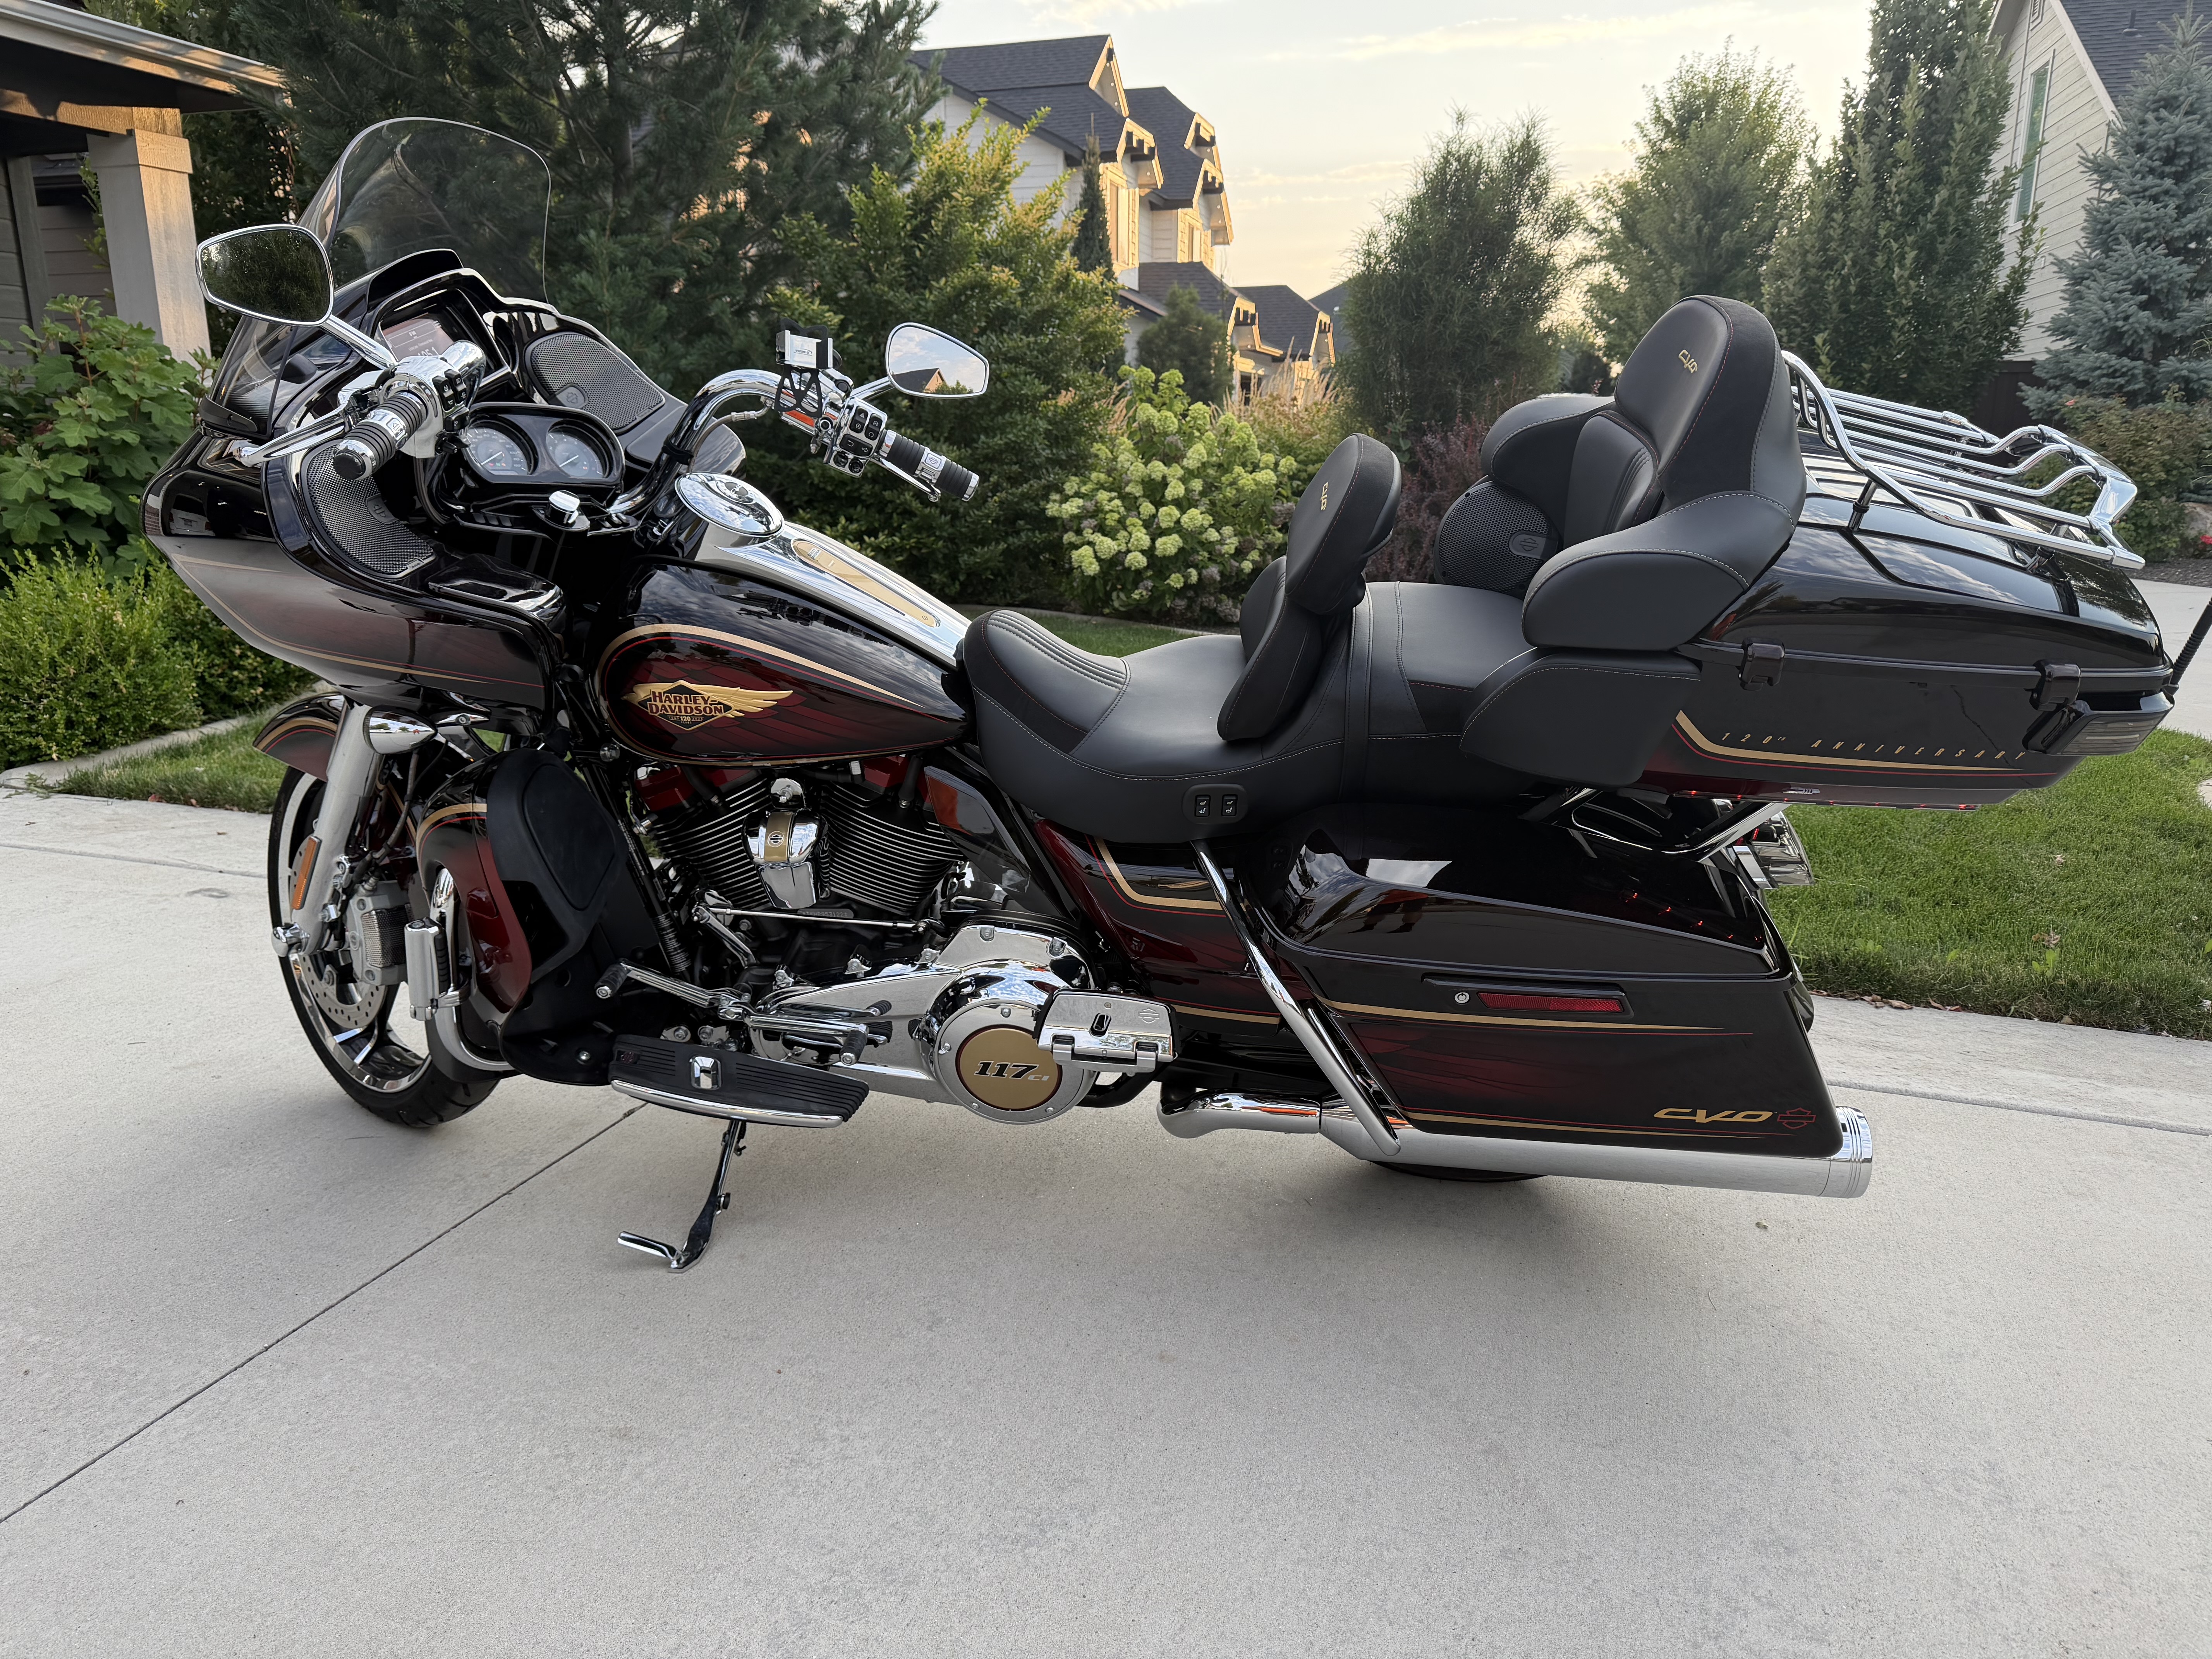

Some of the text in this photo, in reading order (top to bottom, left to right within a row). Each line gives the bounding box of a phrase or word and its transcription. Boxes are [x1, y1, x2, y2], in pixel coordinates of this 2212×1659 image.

[652, 691, 717, 705] HARLEY-
[648, 703, 723, 715] DAVIDSON
[1811, 740, 2026, 760] ANNIVERSARY
[1654, 1108, 1773, 1123] CVO
